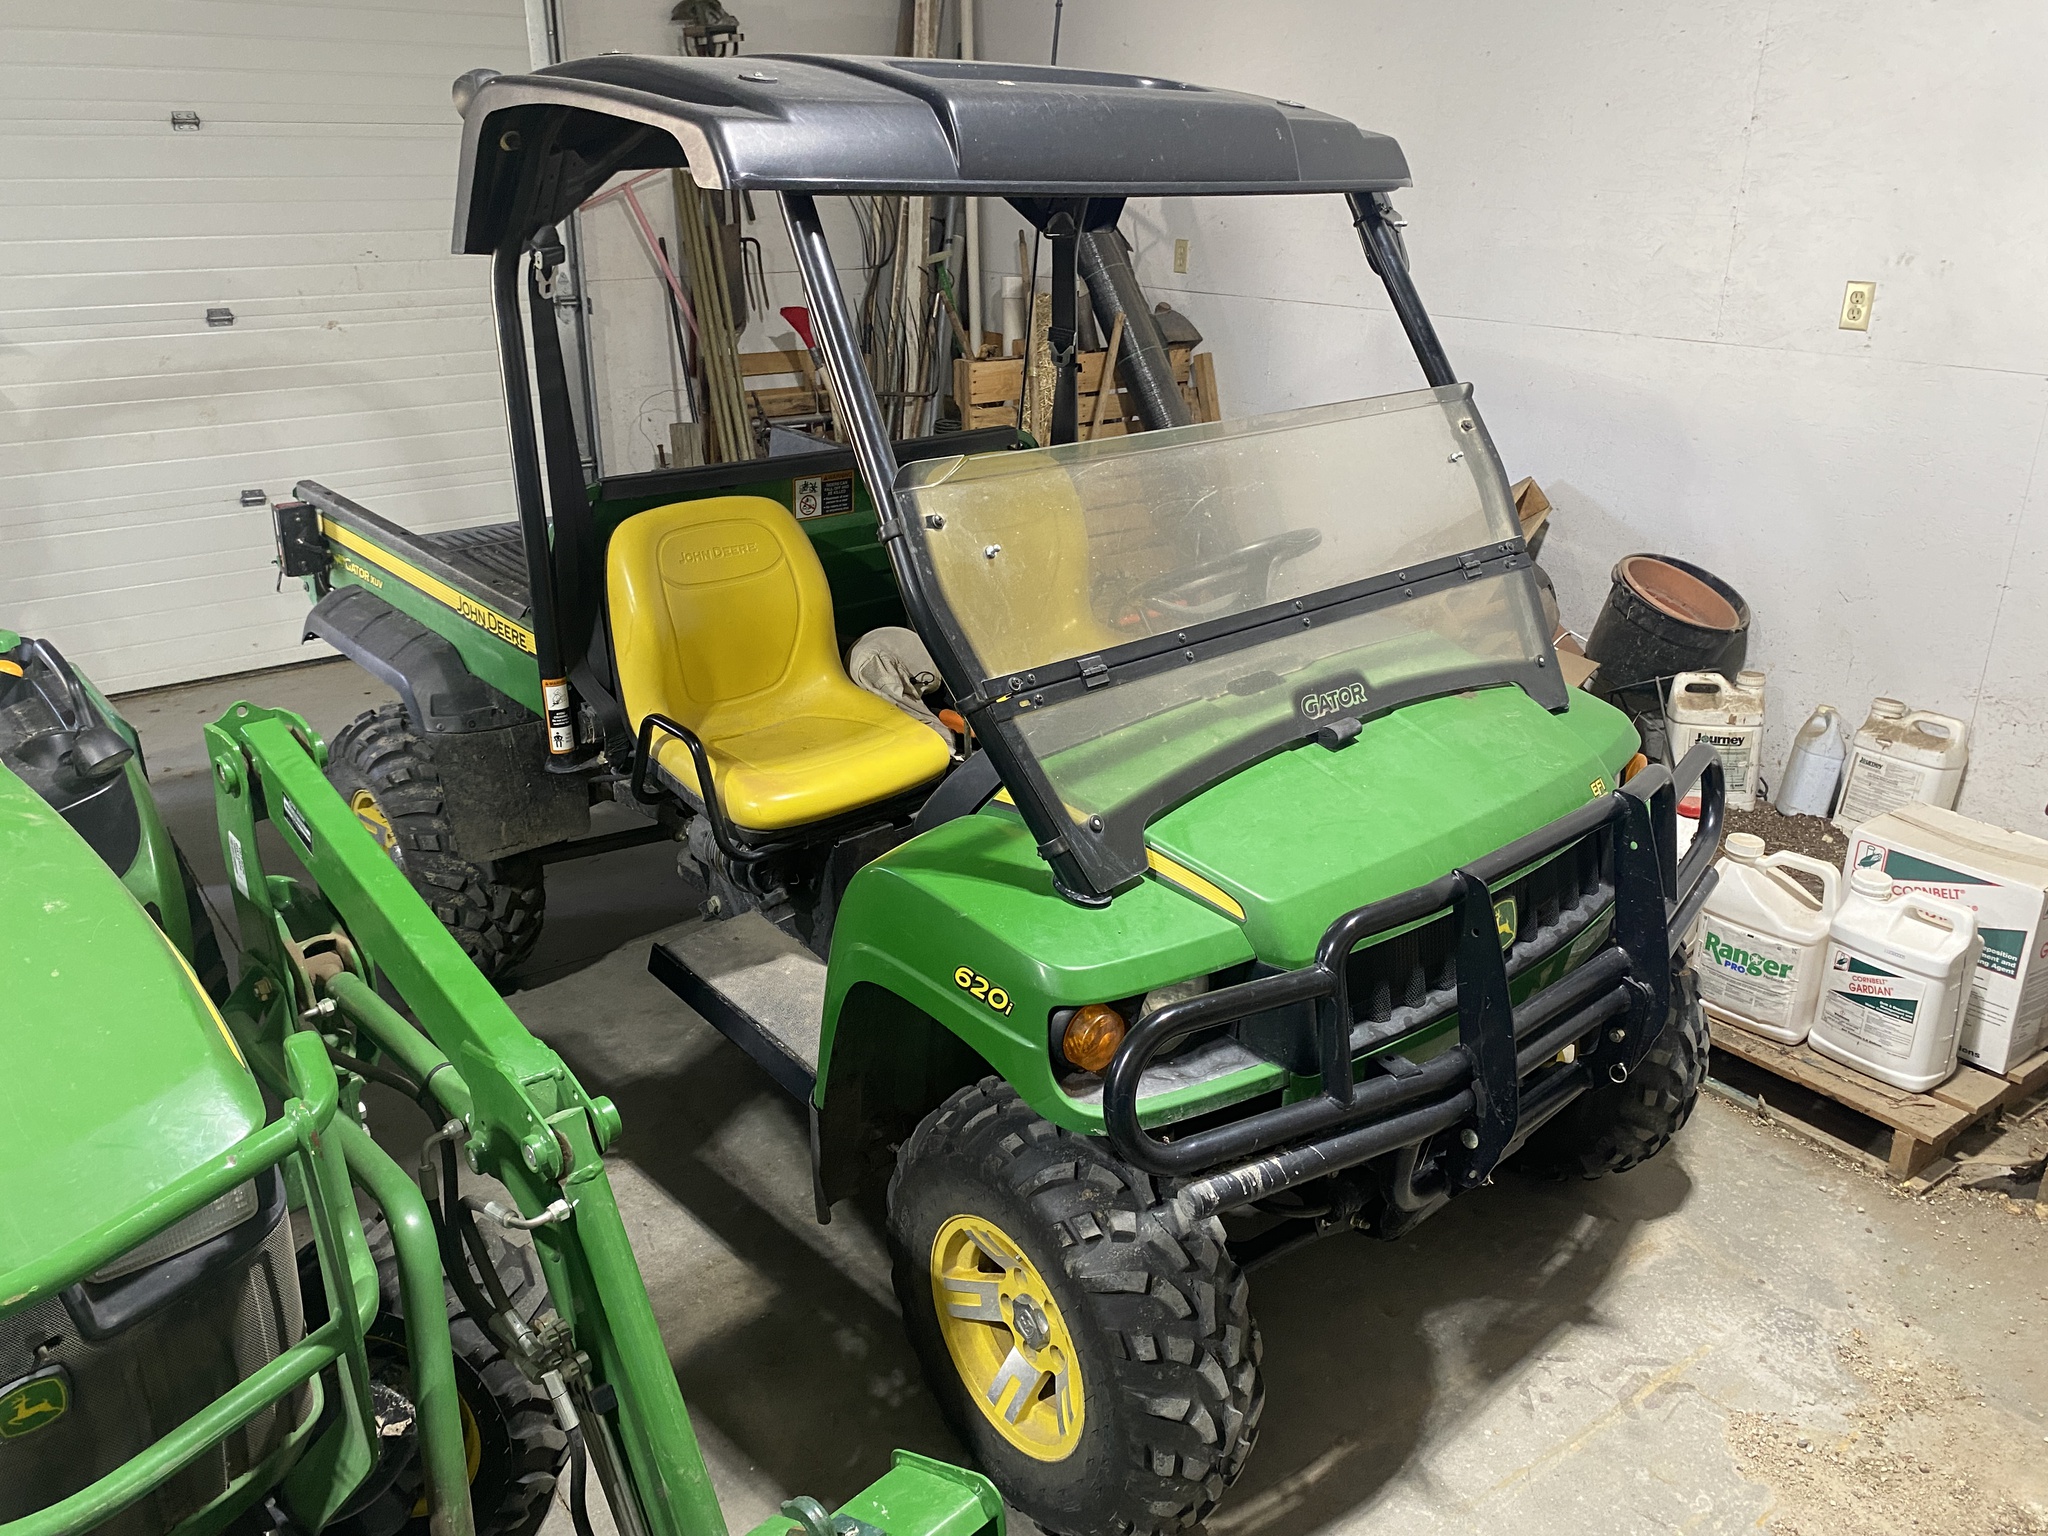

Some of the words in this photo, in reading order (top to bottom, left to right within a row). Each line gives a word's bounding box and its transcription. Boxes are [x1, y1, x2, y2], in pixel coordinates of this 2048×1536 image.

[679, 550, 712, 563] JOHN
[713, 543, 759, 558] DEERE
[344, 557, 370, 582] GATOR
[370, 575, 384, 589] XUV
[457, 596, 486, 628] JOHN
[488, 611, 528, 651] DEERE
[1301, 682, 1368, 720] GATOR
[1695, 732, 1746, 747] Journey
[1705, 931, 1794, 979] Ranger
[1724, 959, 1746, 974] PRO
[2000, 959, 2017, 969] and
[1991, 962, 2015, 976] Agent
[953, 966, 1015, 1017] 620i
